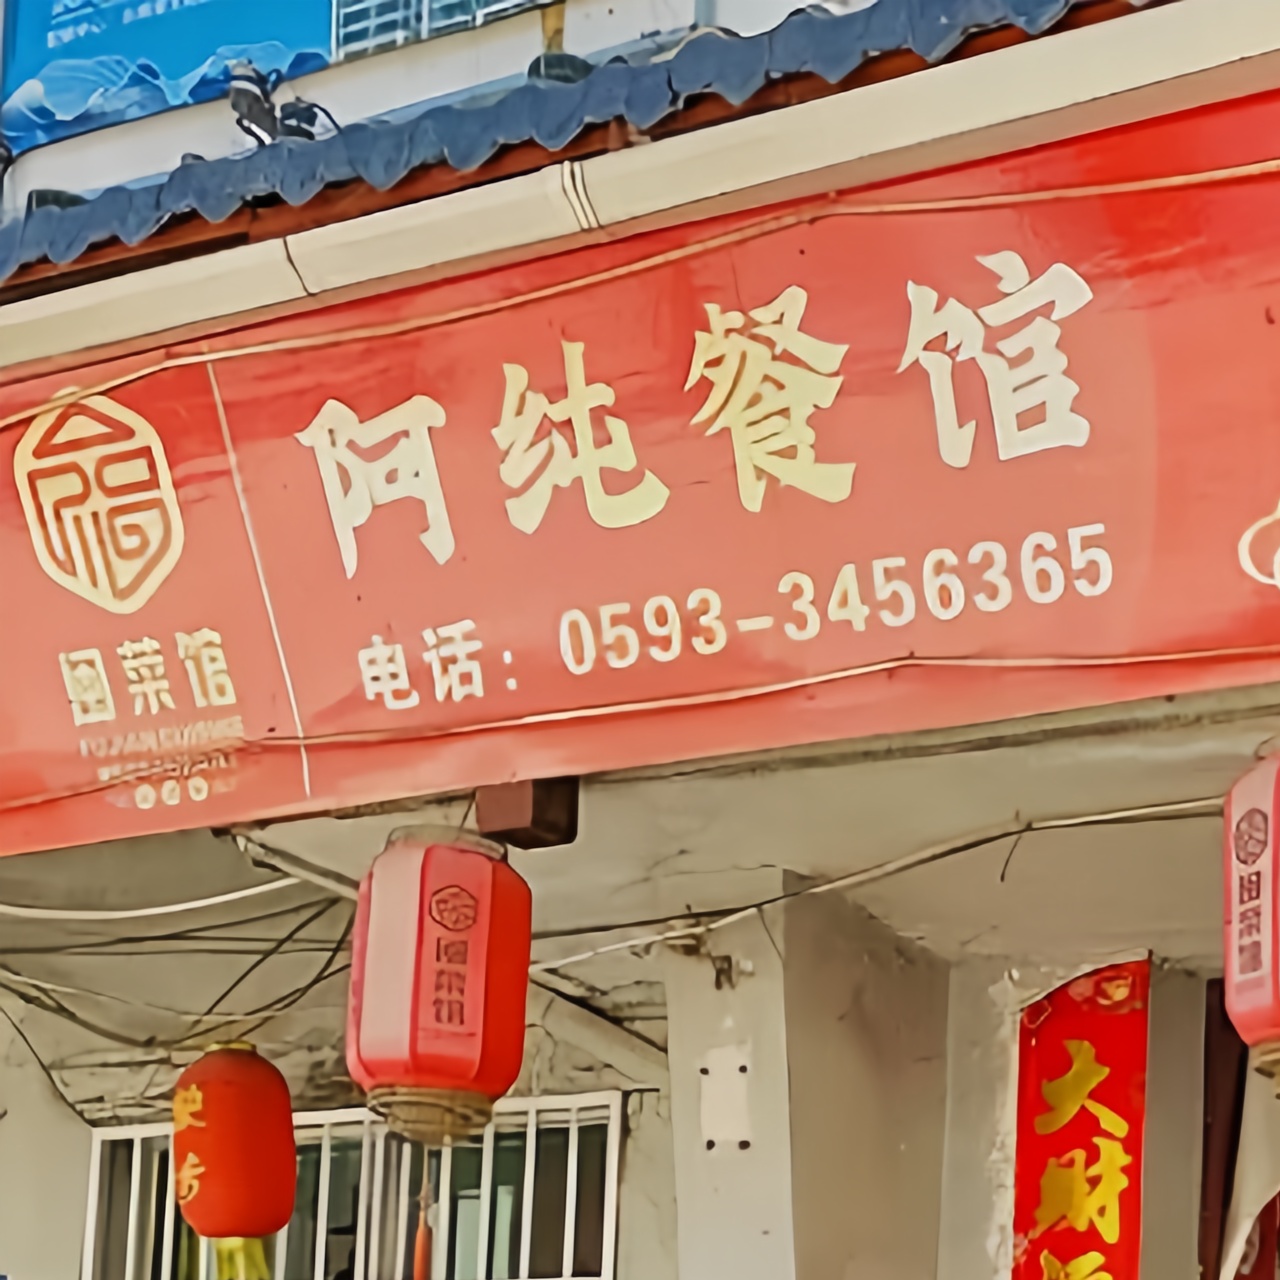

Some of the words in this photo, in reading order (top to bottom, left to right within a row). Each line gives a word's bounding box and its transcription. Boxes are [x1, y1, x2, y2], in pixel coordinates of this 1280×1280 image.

[295, 250, 1093, 579] 阿纯餐馆
[559, 522, 1113, 677] 0593-3456365
